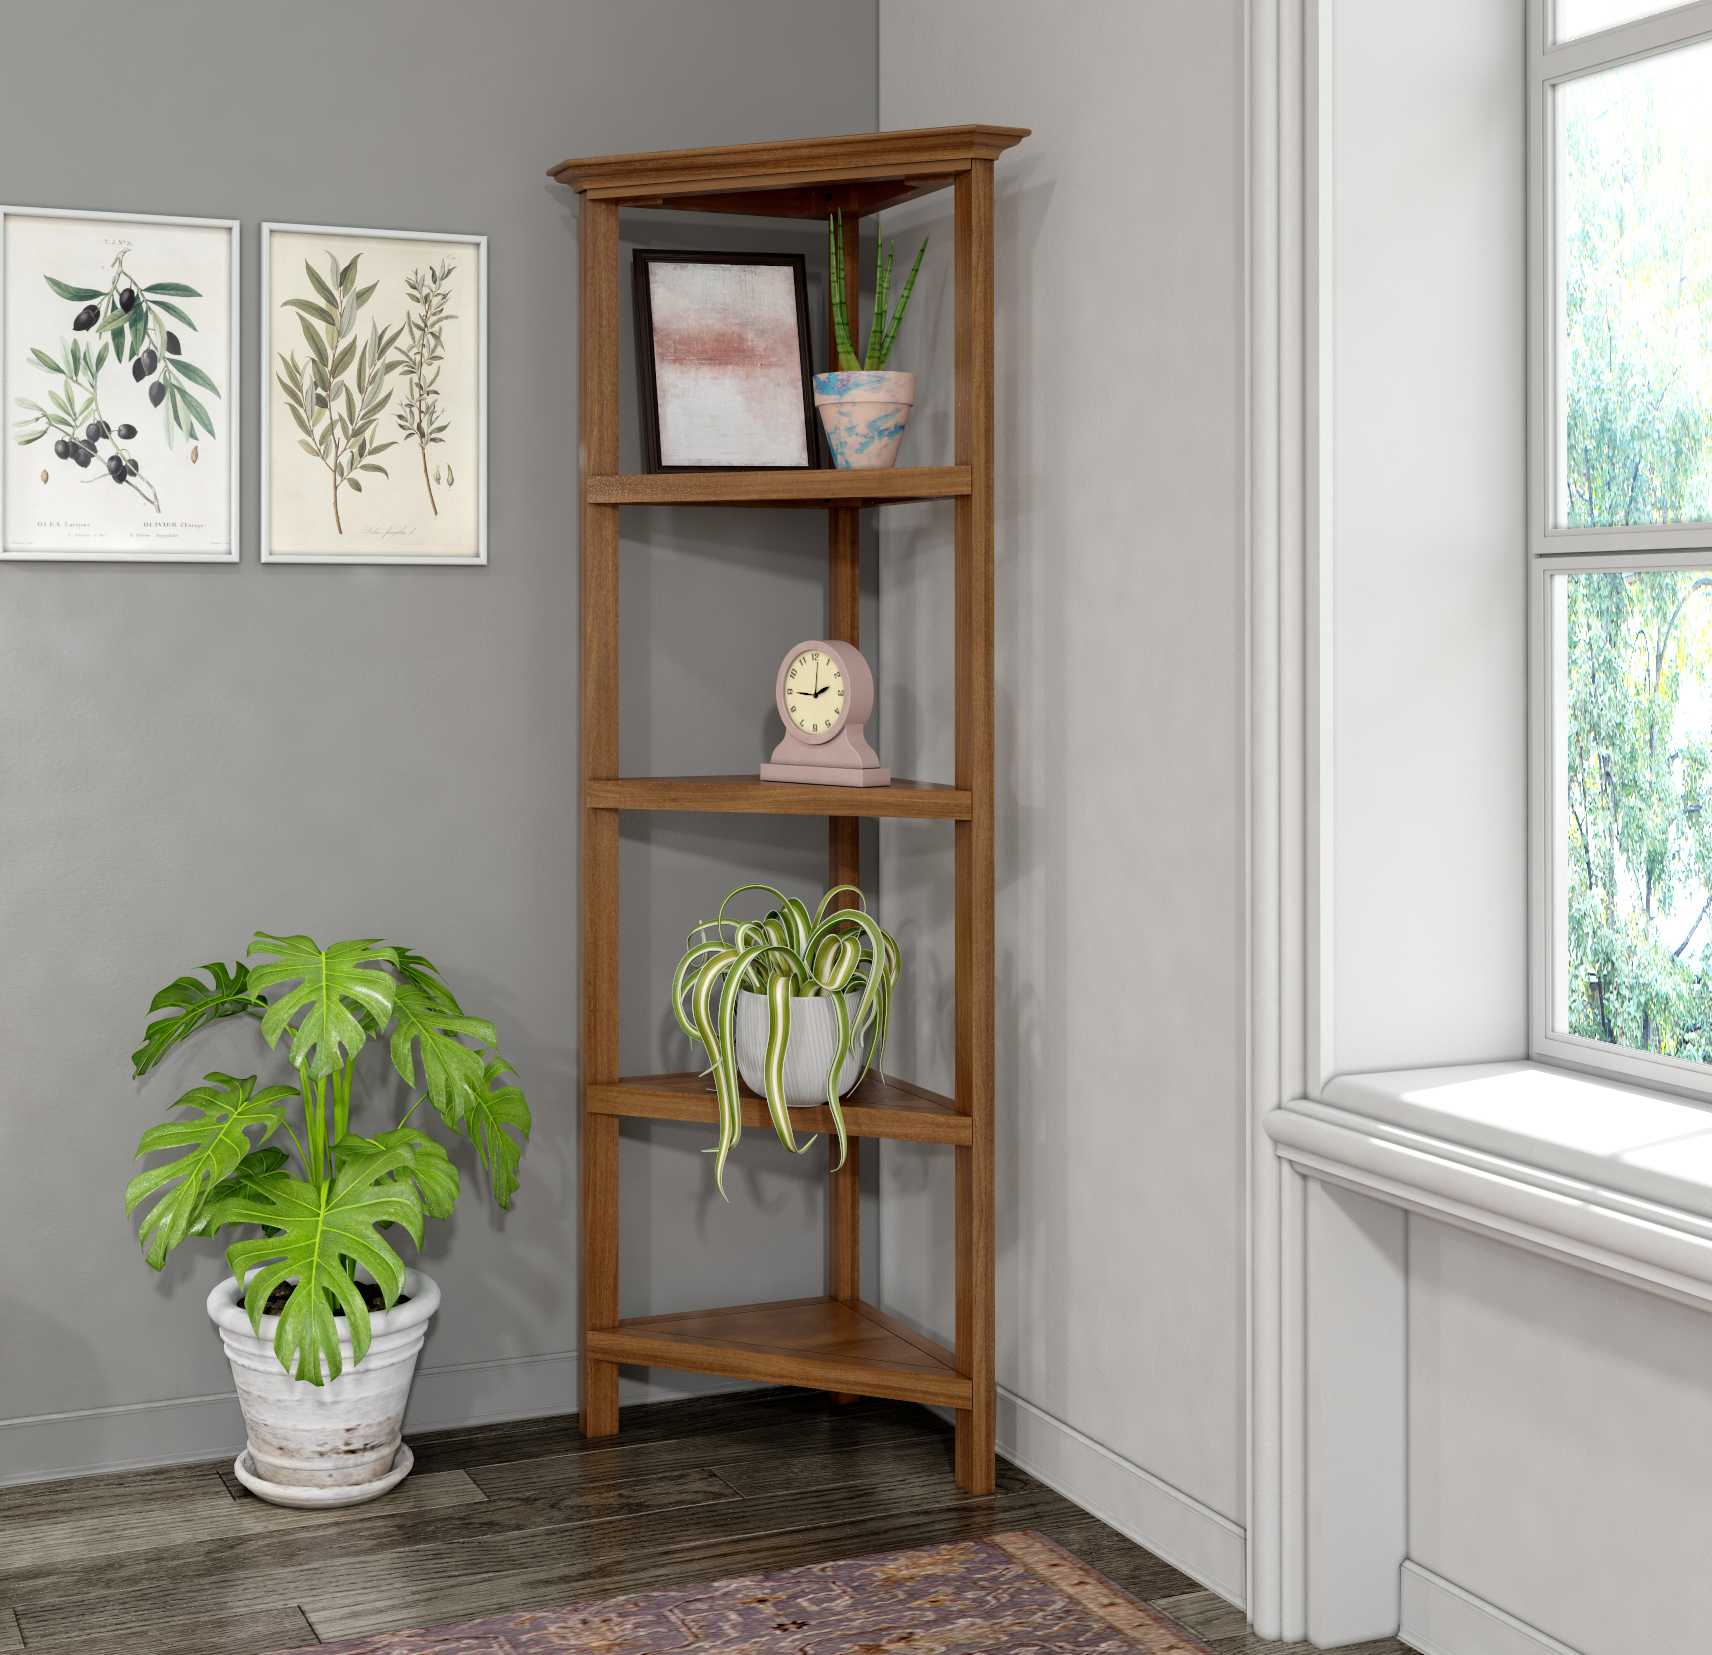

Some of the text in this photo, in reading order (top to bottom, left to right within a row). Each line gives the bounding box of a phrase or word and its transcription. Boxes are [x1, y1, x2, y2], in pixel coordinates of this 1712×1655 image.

[811, 653, 820, 661] 12
[799, 657, 807, 666] 11
[826, 658, 831, 666] 1
[790, 668, 798, 680] 10
[833, 671, 841, 679] 2
[837, 689, 844, 697] 3
[834, 707, 840, 715] 4
[799, 719, 805, 727] 7
